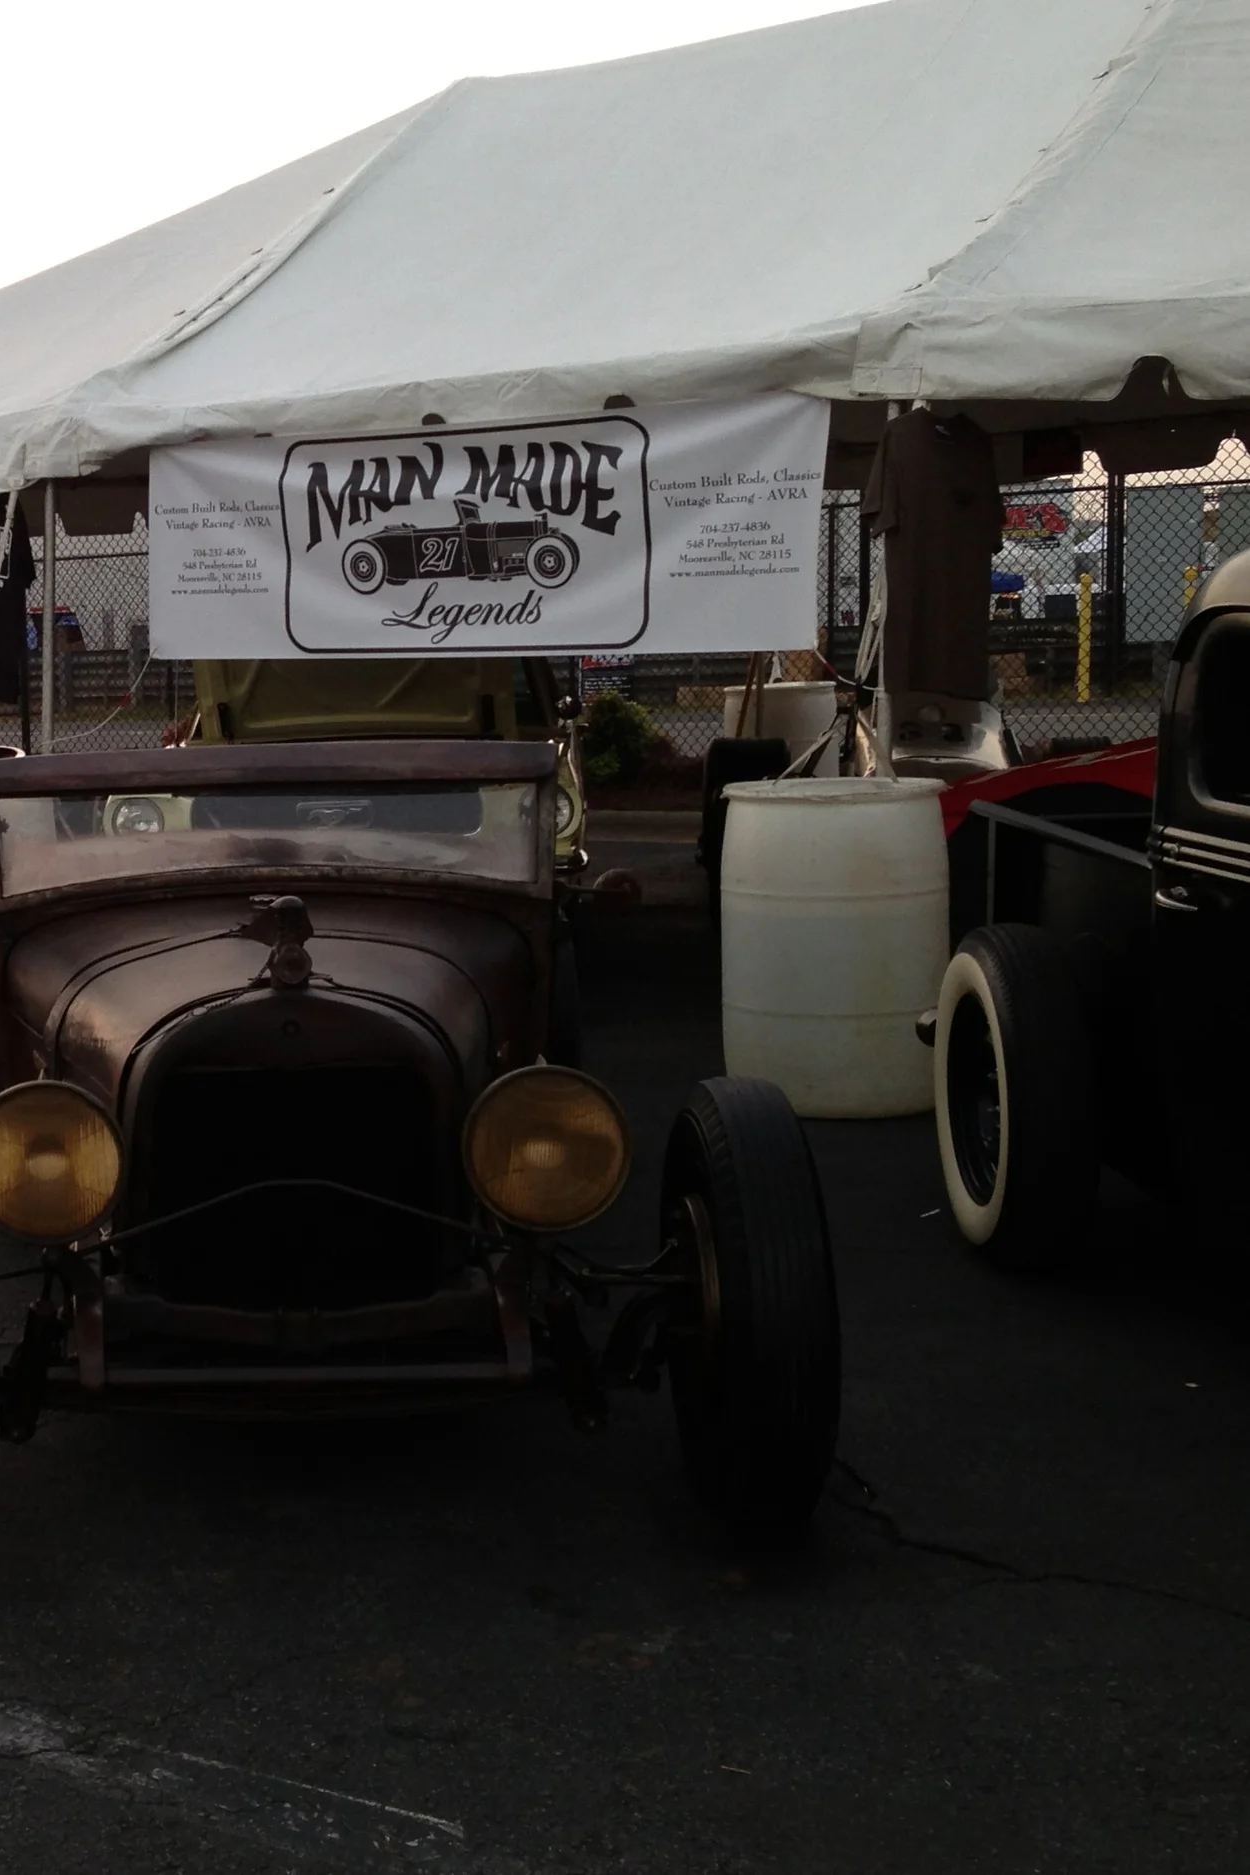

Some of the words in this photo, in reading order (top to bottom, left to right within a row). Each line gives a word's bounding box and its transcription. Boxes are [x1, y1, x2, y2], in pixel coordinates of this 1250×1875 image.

[649, 479, 697, 492] Custom
[701, 473, 733, 488] Built
[737, 470, 769, 485] Rods,
[773, 468, 821, 482] Classics
[306, 442, 444, 552] MAN
[454, 440, 624, 536] MADE
[663, 496, 711, 508] Vintage
[715, 492, 756, 505] Racing
[766, 488, 808, 501] AVRA
[154, 504, 189, 515] Custom
[192, 501, 216, 513] Built
[219, 500, 243, 513] Rods,
[245, 500, 280, 512] Classics
[165, 519, 199, 531] Vintage
[202, 518, 235, 529] Racing
[243, 516, 272, 528] AVRA
[700, 521, 771, 534] 704-237-4836
[686, 540, 704, 550] 548
[707, 536, 767, 551] Presbyterian
[771, 533, 785, 545] Rd
[192, 547, 247, 558] 704-237-4836
[419, 536, 460, 573] 21
[678, 551, 735, 565] Mooresville,
[738, 549, 755, 562] NC
[758, 548, 792, 561] 28115
[182, 561, 197, 571] 548
[199, 560, 243, 571] Presbyterian
[245, 558, 257, 569] Rd
[669, 564, 800, 577] www.manmadelegends.com
[222, 572, 236, 582] NC
[236, 571, 262, 582] 28115
[171, 584, 269, 595] www.manmadelegends.com
[381, 581, 544, 645] Legends
